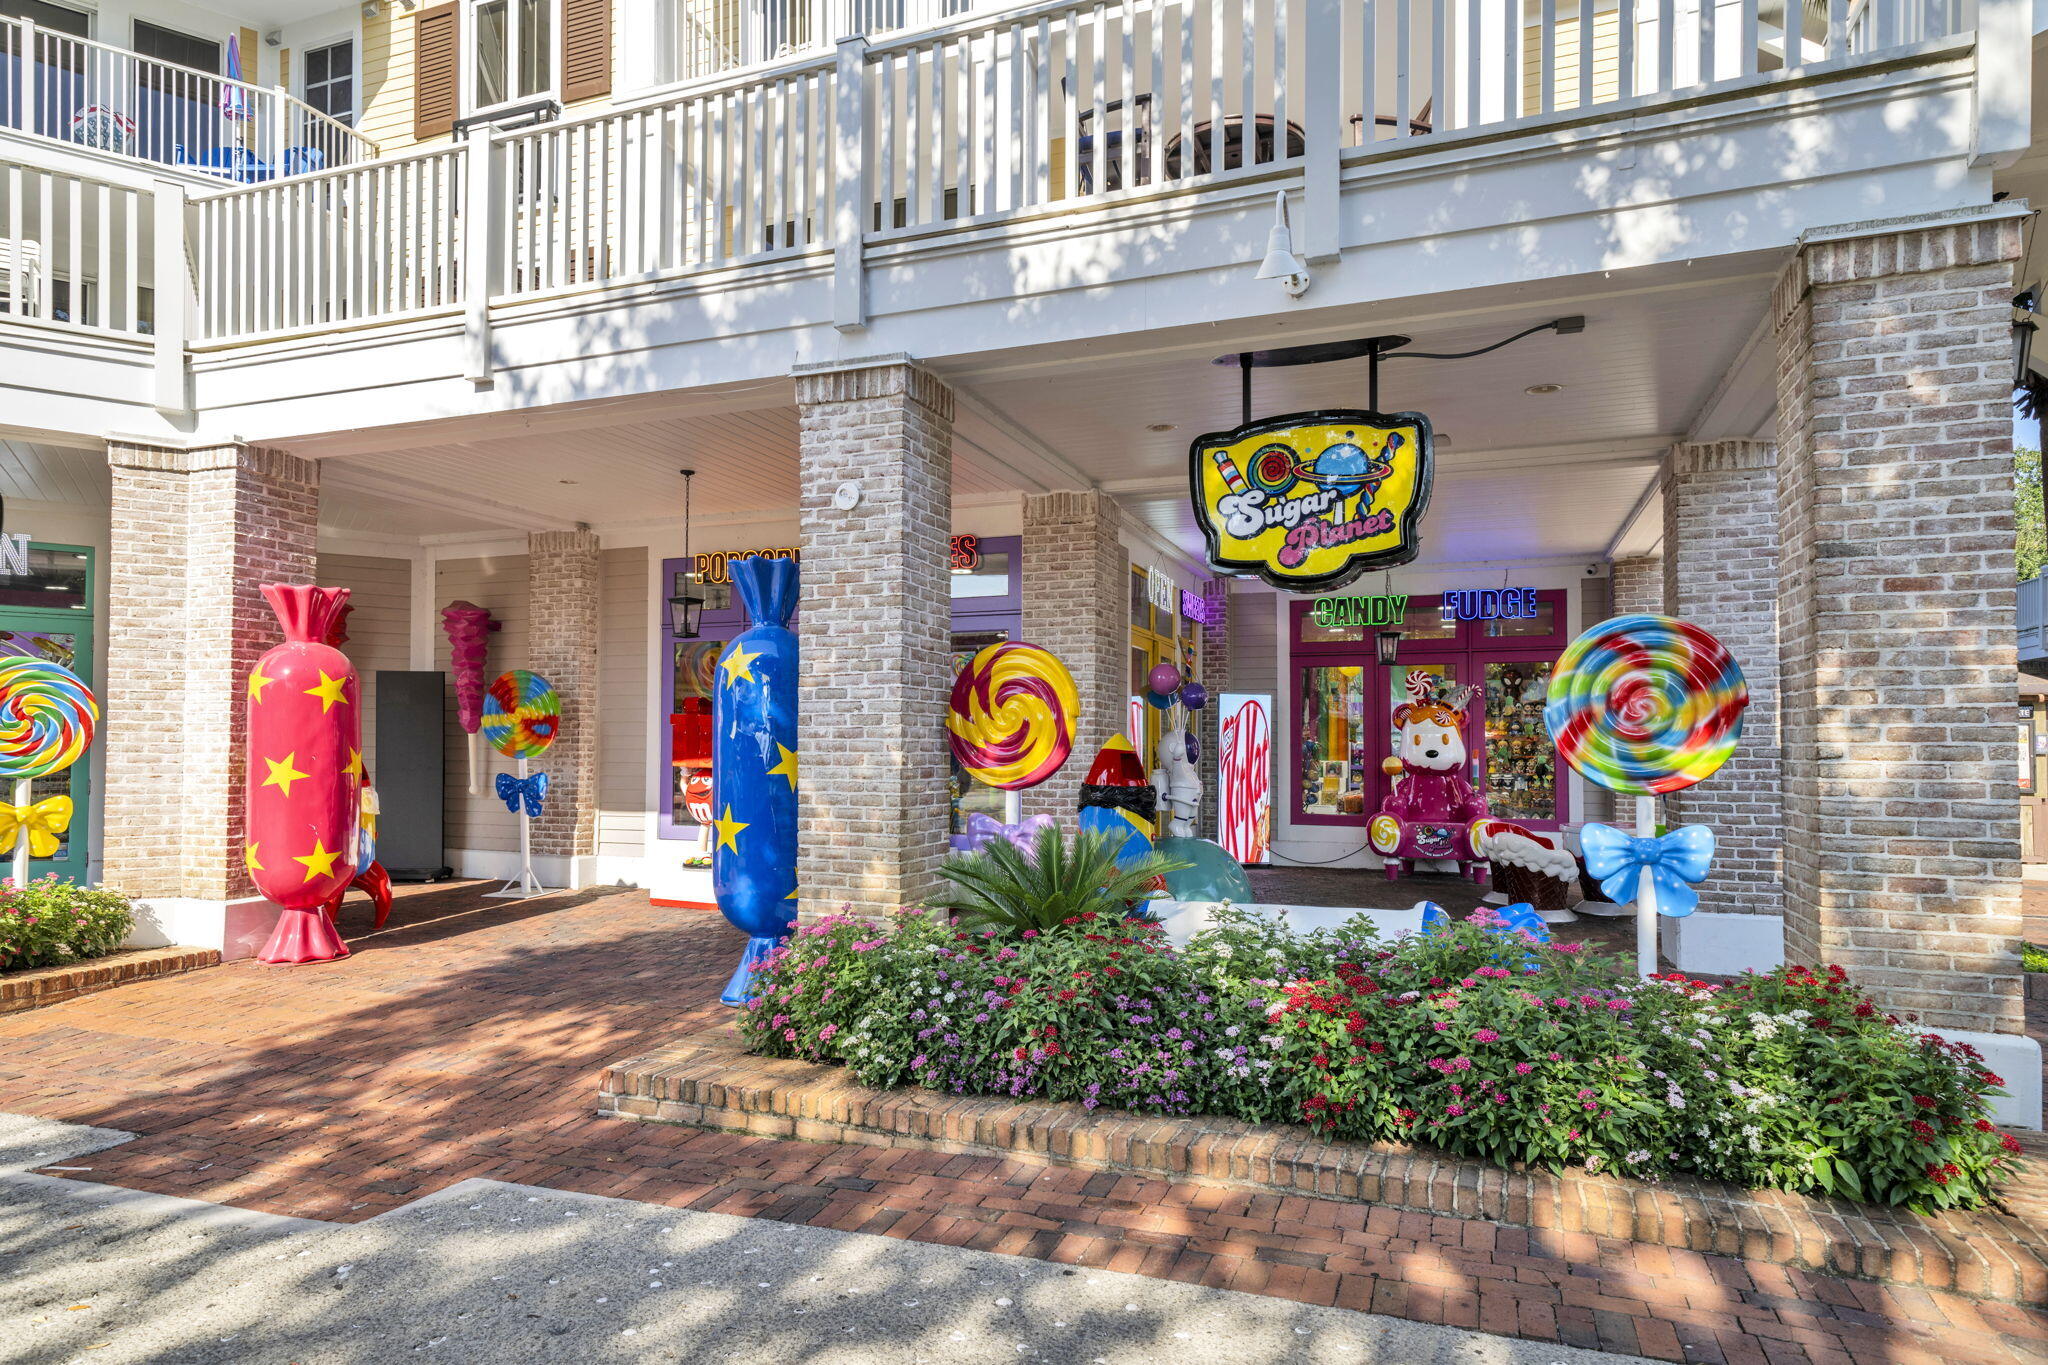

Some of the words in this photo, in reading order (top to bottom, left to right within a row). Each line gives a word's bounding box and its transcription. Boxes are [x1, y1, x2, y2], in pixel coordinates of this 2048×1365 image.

[1218, 489, 1338, 538] Sugar
[1278, 510, 1394, 566] Planet
[1148, 565, 1174, 615] OPEN
[1314, 594, 1408, 628] CANDY
[1442, 587, 1537, 621] FUDGE
